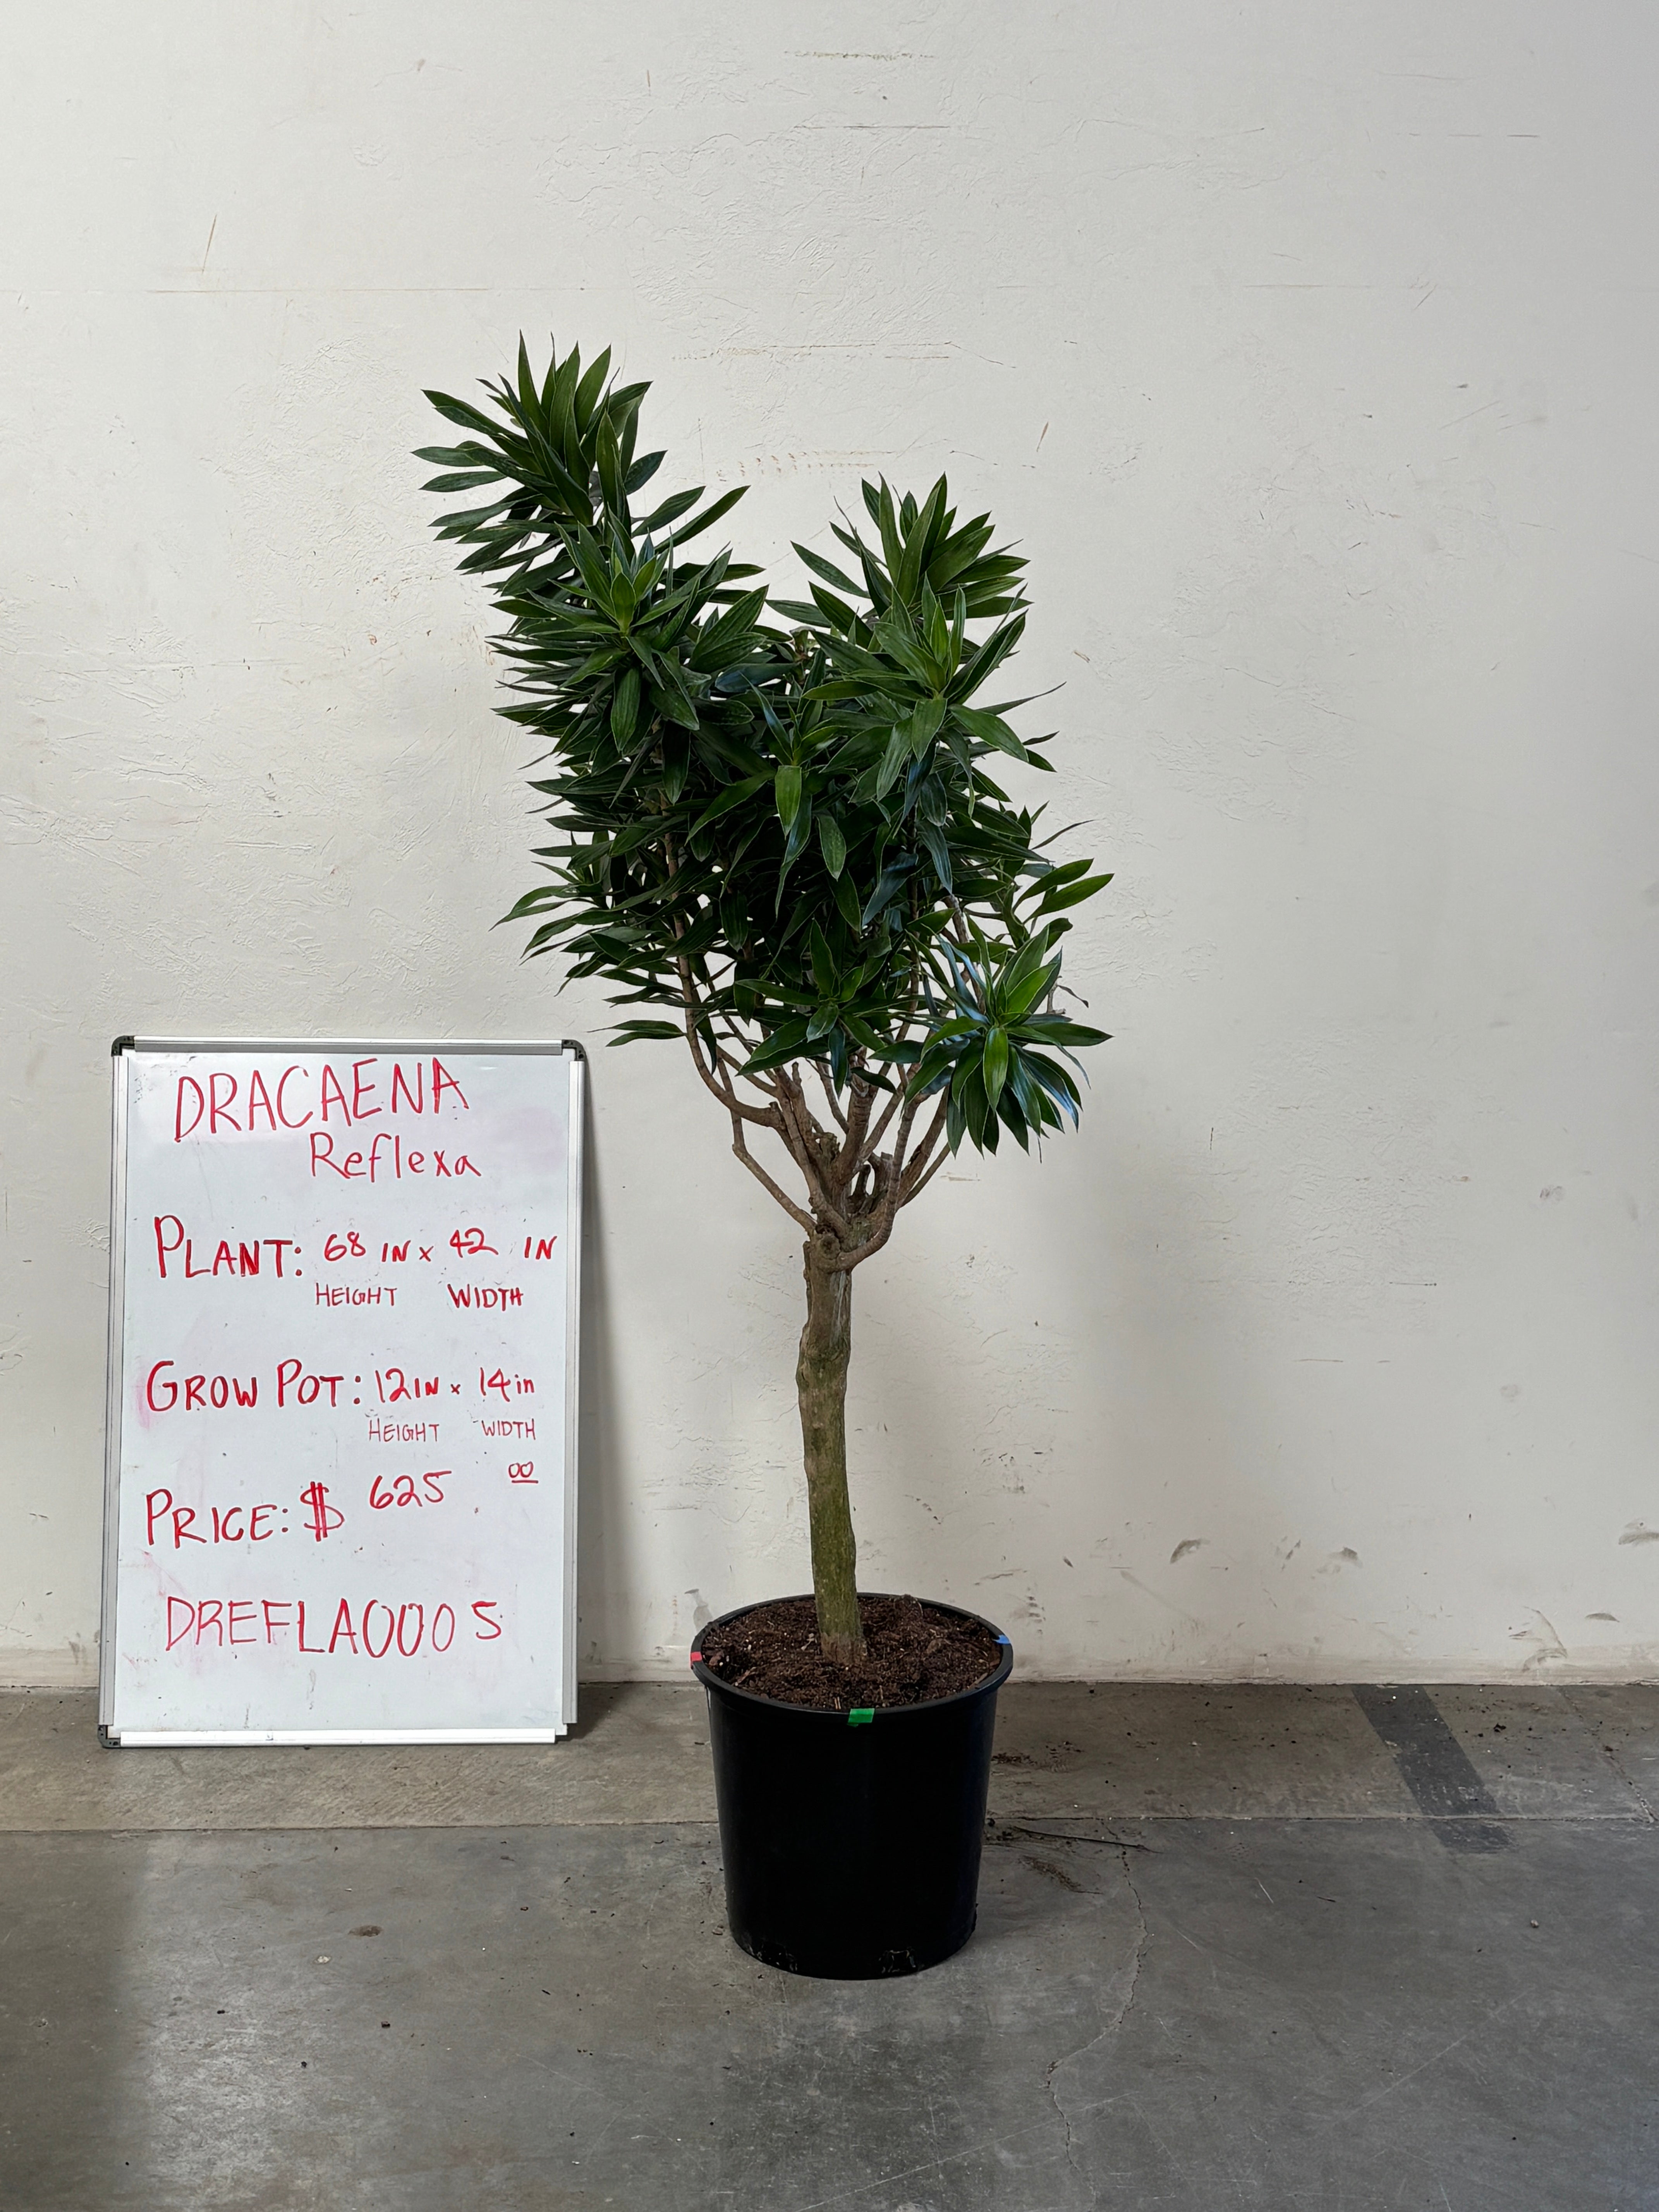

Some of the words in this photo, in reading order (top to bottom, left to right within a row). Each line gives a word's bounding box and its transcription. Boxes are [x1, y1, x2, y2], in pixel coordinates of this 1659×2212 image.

[174, 1057, 469, 1142] DRACAENA
[309, 1132, 481, 1182] Reflexa
[154, 1216, 302, 1278] PLANT:
[323, 1231, 366, 1262] 68
[381, 1240, 410, 1262] IN
[449, 1228, 499, 1258] 42
[524, 1236, 557, 1260] IN
[315, 1283, 397, 1307] HEIGHT
[447, 1284, 524, 1311] WIDTH
[146, 1360, 258, 1412] GROW
[276, 1359, 360, 1407] POT:
[369, 1418, 440, 1442] HEIGHT
[481, 1418, 536, 1440] WIDTH
[146, 1489, 289, 1548] PRICE:
[369, 1470, 452, 1510] 625
